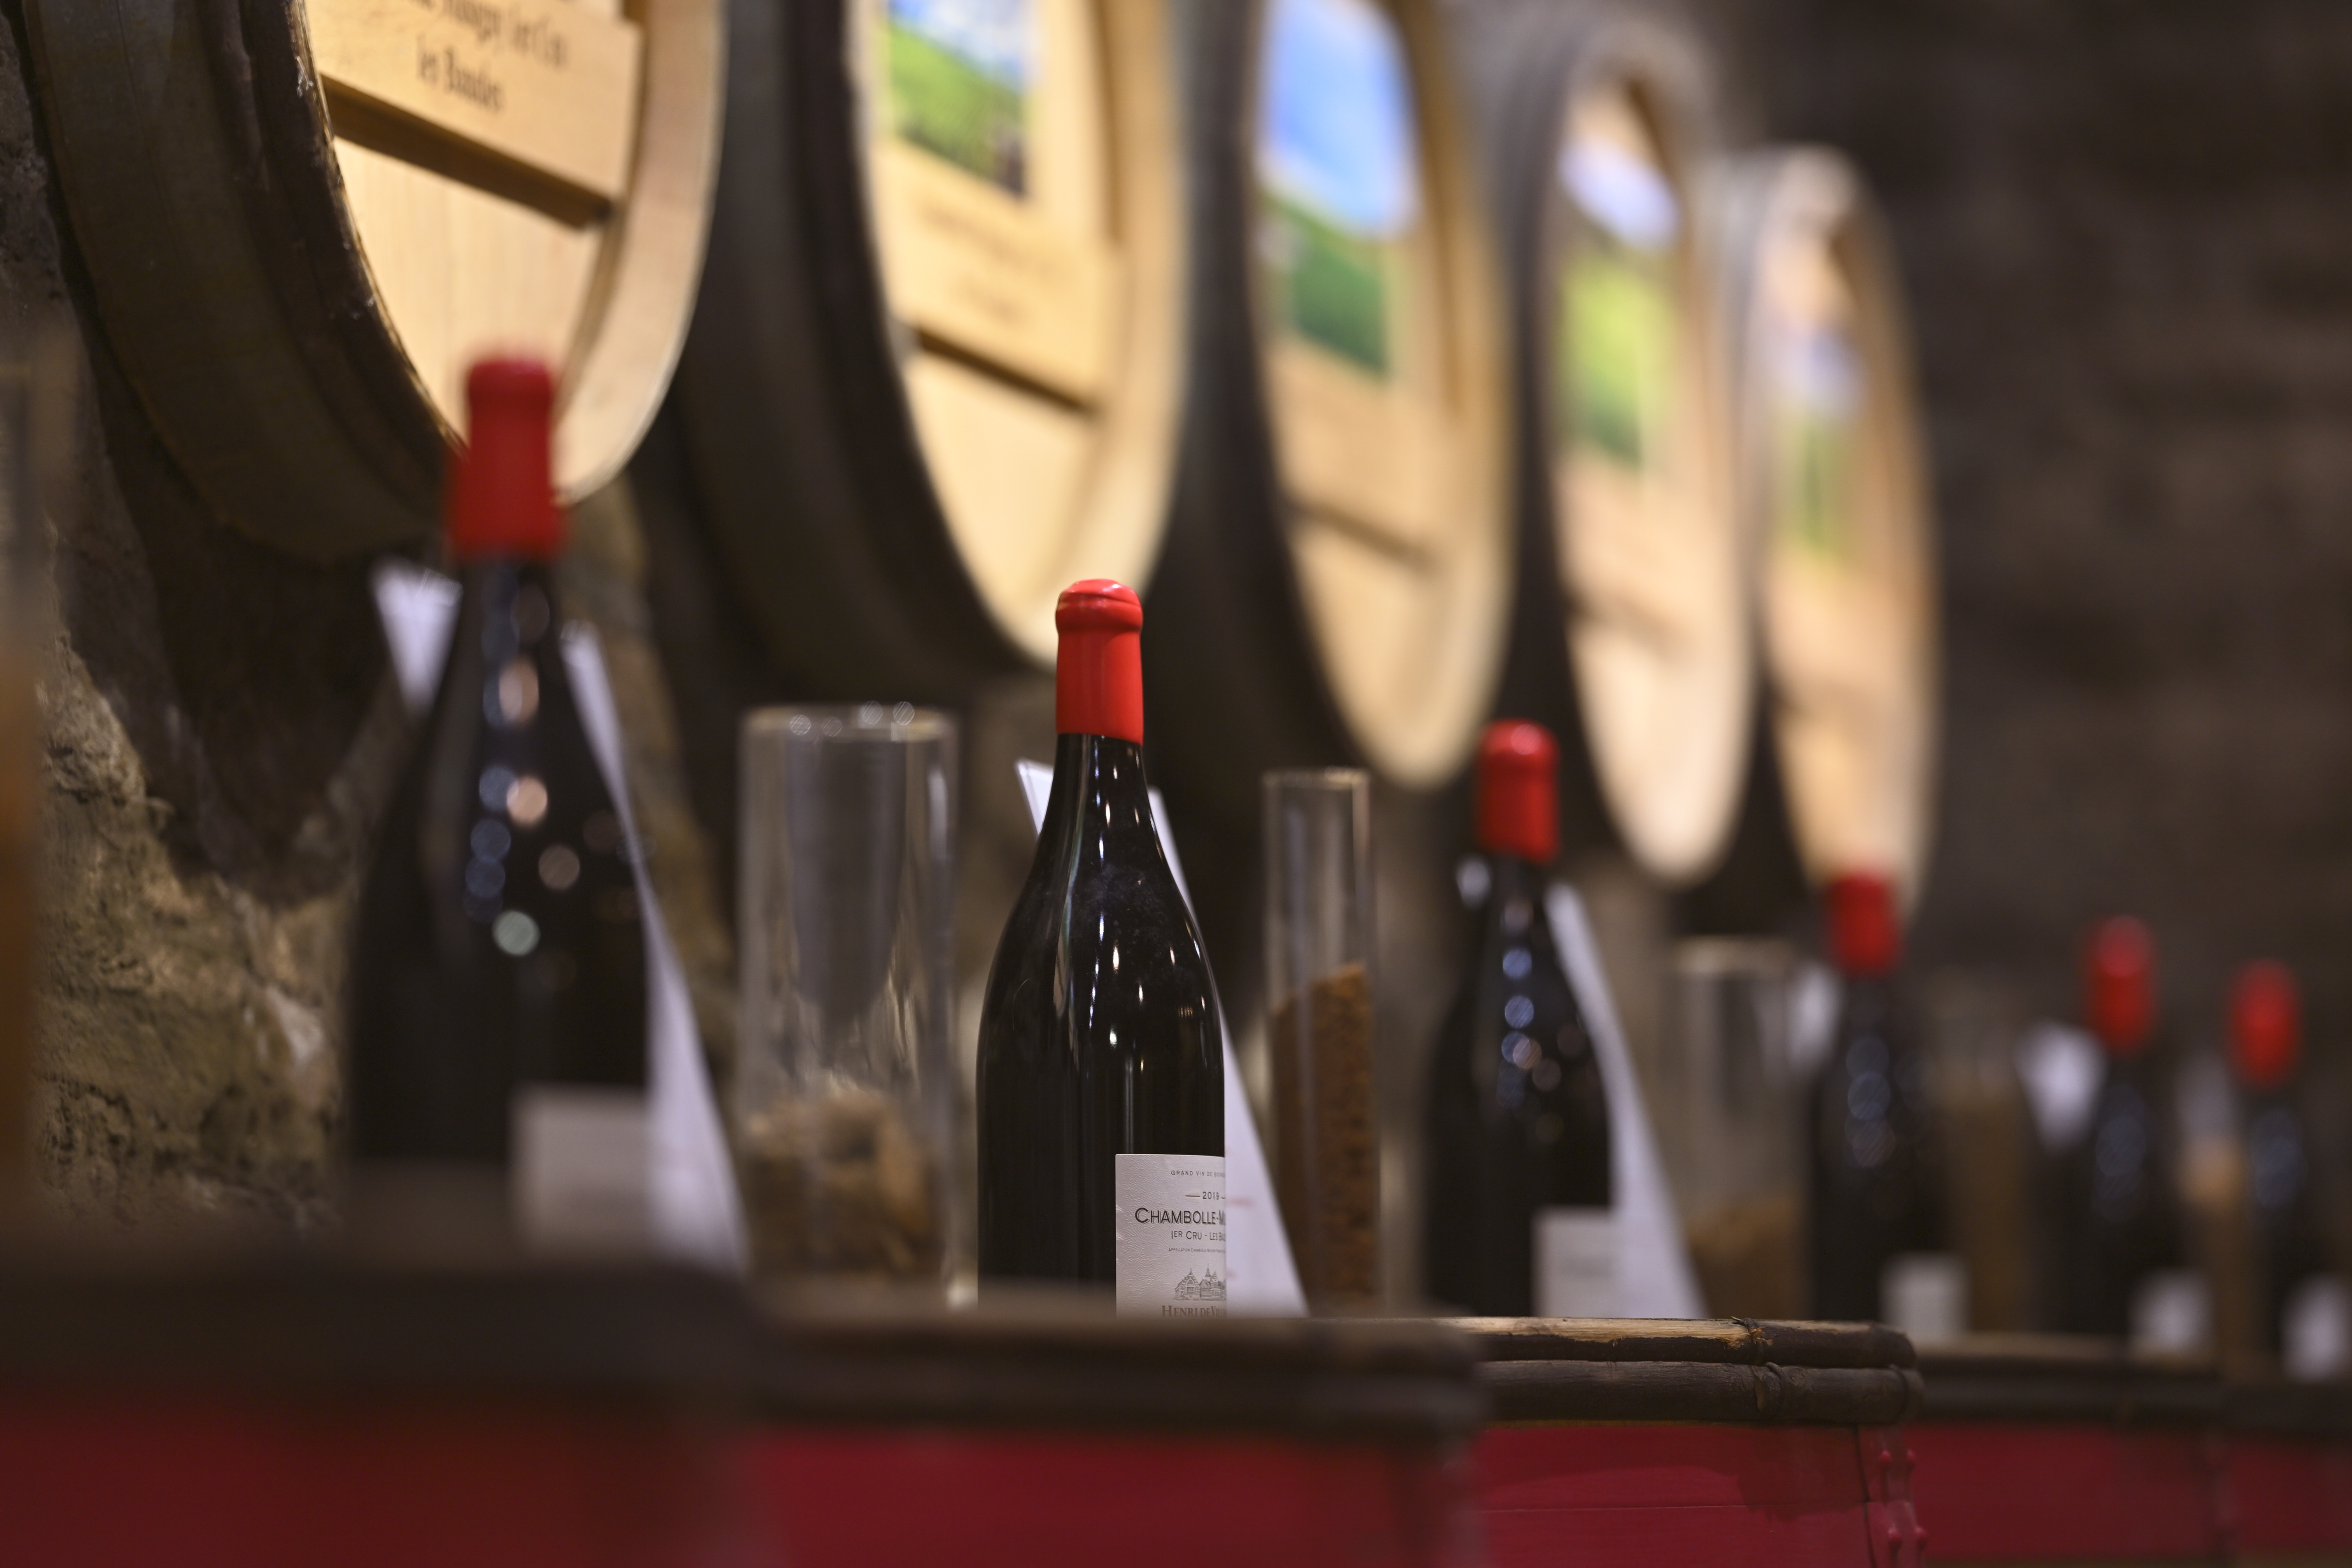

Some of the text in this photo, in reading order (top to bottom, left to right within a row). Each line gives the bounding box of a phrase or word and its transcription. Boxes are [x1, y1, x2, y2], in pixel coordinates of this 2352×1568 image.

[1202, 1191, 1219, 1200] 2019
[1186, 1231, 1202, 1240] CRU
[1209, 1232, 1218, 1241] LES
[1162, 1305, 1197, 1317] HENRI
[1200, 1308, 1209, 1318] DE
